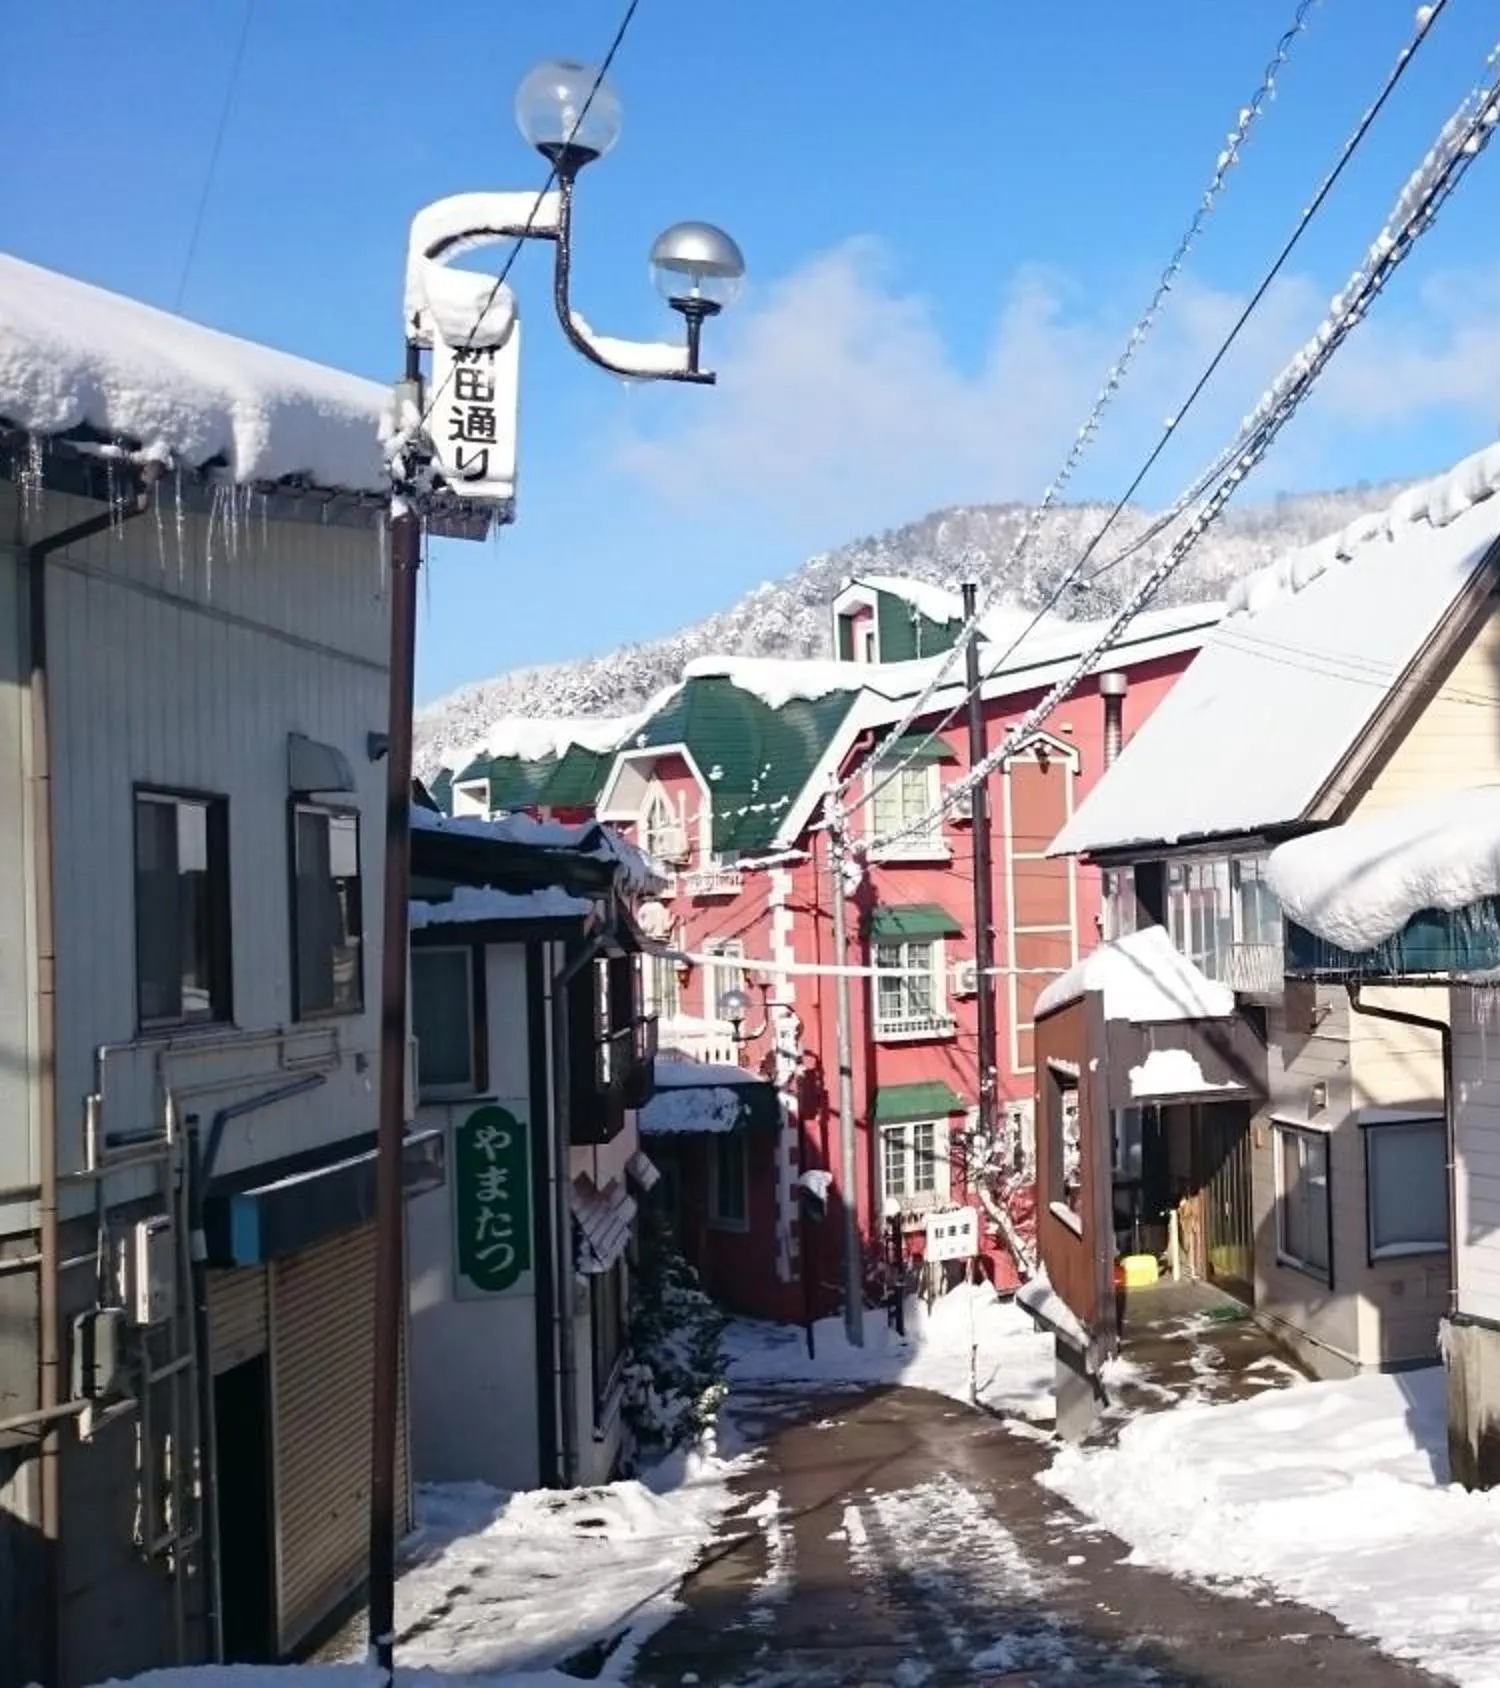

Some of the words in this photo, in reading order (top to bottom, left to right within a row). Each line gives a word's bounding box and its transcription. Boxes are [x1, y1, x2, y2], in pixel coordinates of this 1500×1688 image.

[448, 349, 497, 482] 田通り
[472, 1124, 515, 1273] やまたつ
